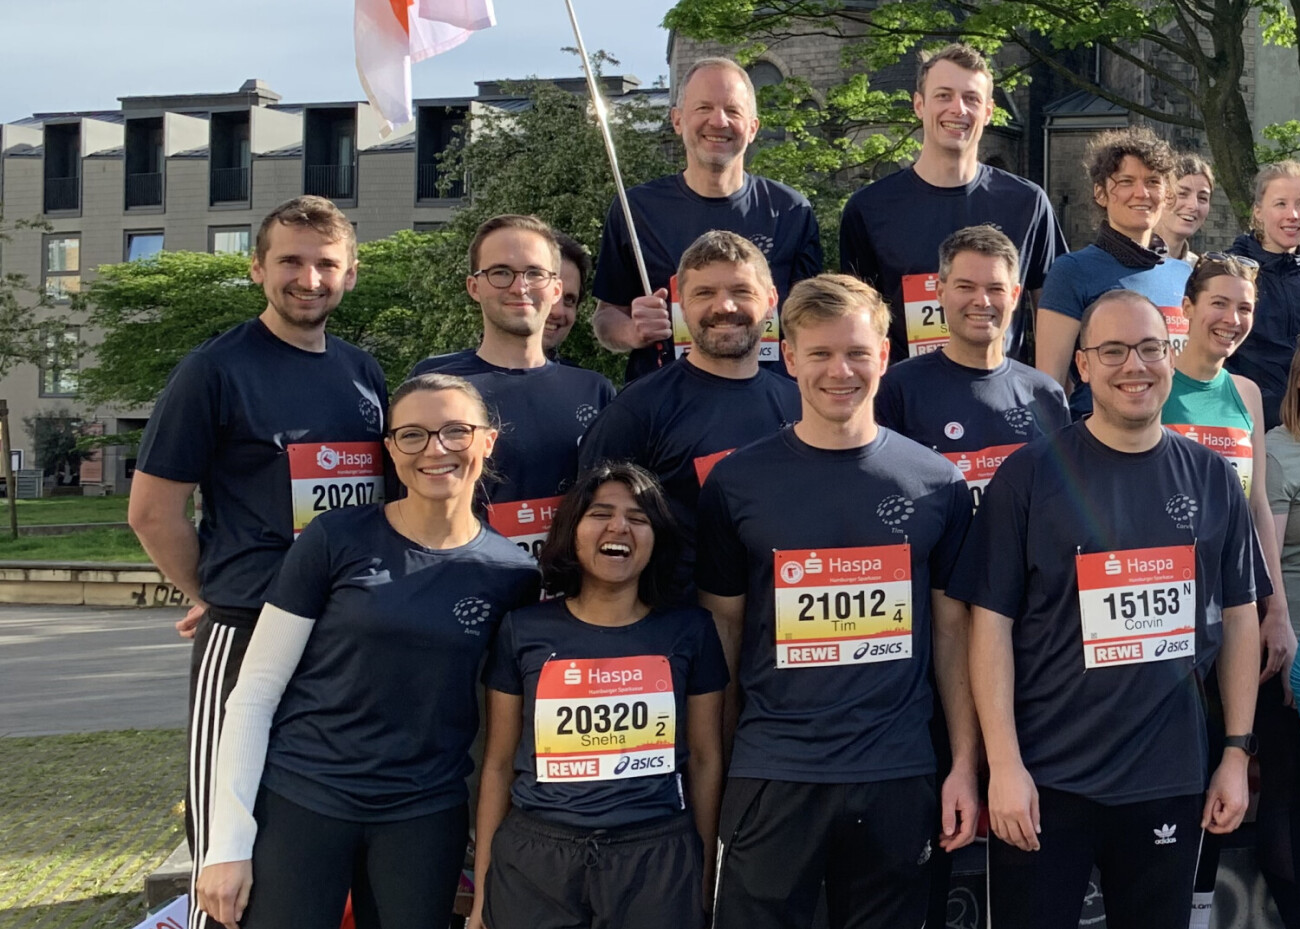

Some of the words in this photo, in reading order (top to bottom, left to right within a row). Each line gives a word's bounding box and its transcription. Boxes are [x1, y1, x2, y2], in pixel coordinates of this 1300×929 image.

[1202, 433, 1238, 449] Haspa
[337, 451, 373, 468] Haspa
[312, 482, 375, 511] 20207
[829, 557, 882, 575] Haspa
[1127, 558, 1174, 574] Haspa
[798, 589, 886, 622] 21012
[1103, 587, 1180, 620] 15153
[1183, 582, 1192, 596] N
[893, 608, 904, 623] 4
[1124, 617, 1164, 630] Corvin
[831, 620, 856, 632] Tim
[789, 646, 838, 662] REWE
[1096, 644, 1141, 661] REWE
[588, 668, 643, 685] Haspa
[556, 701, 648, 735] 20320
[655, 722, 666, 737] 2
[580, 733, 626, 747] Sneha
[548, 761, 597, 776] REWE
